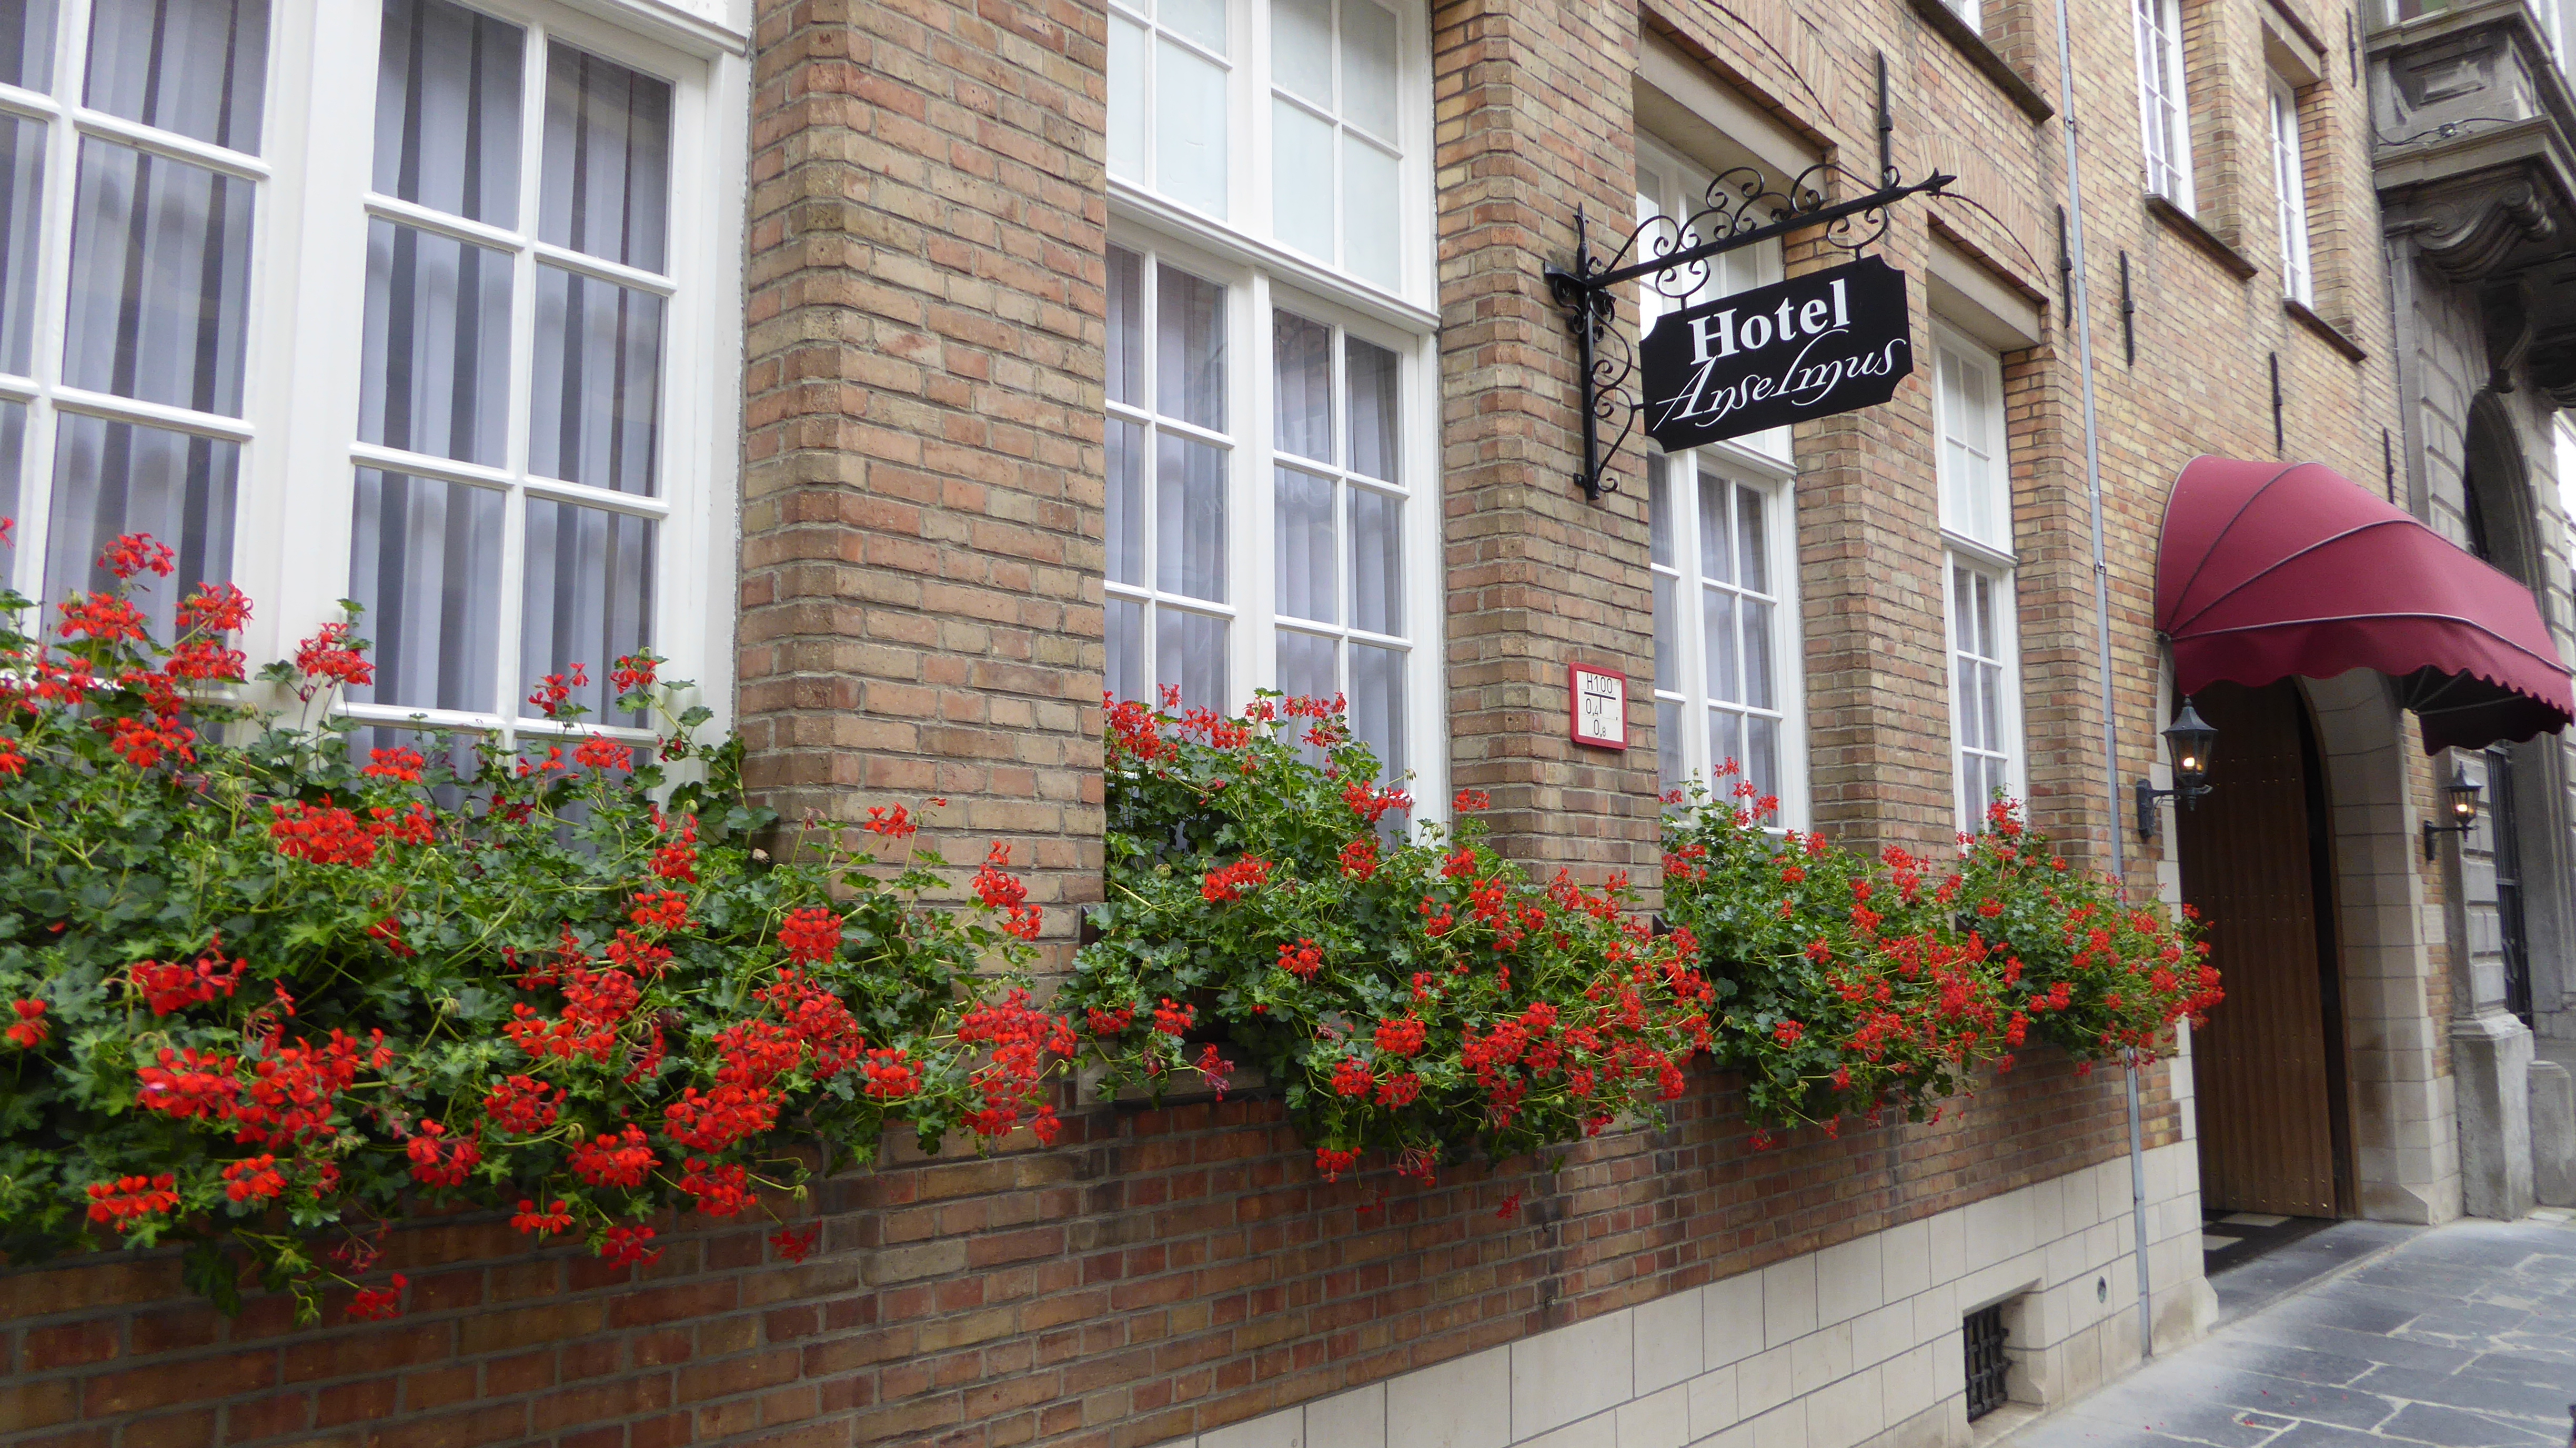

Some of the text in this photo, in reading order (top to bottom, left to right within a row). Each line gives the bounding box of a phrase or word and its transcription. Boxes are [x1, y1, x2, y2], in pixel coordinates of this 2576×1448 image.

[1688, 278, 1850, 365] Hotel
[1653, 328, 1907, 431] Anselmus
[1587, 674, 1612, 693] H100
[1586, 698, 1598, 716] 0,4
[1594, 719, 1606, 737] 0,8
